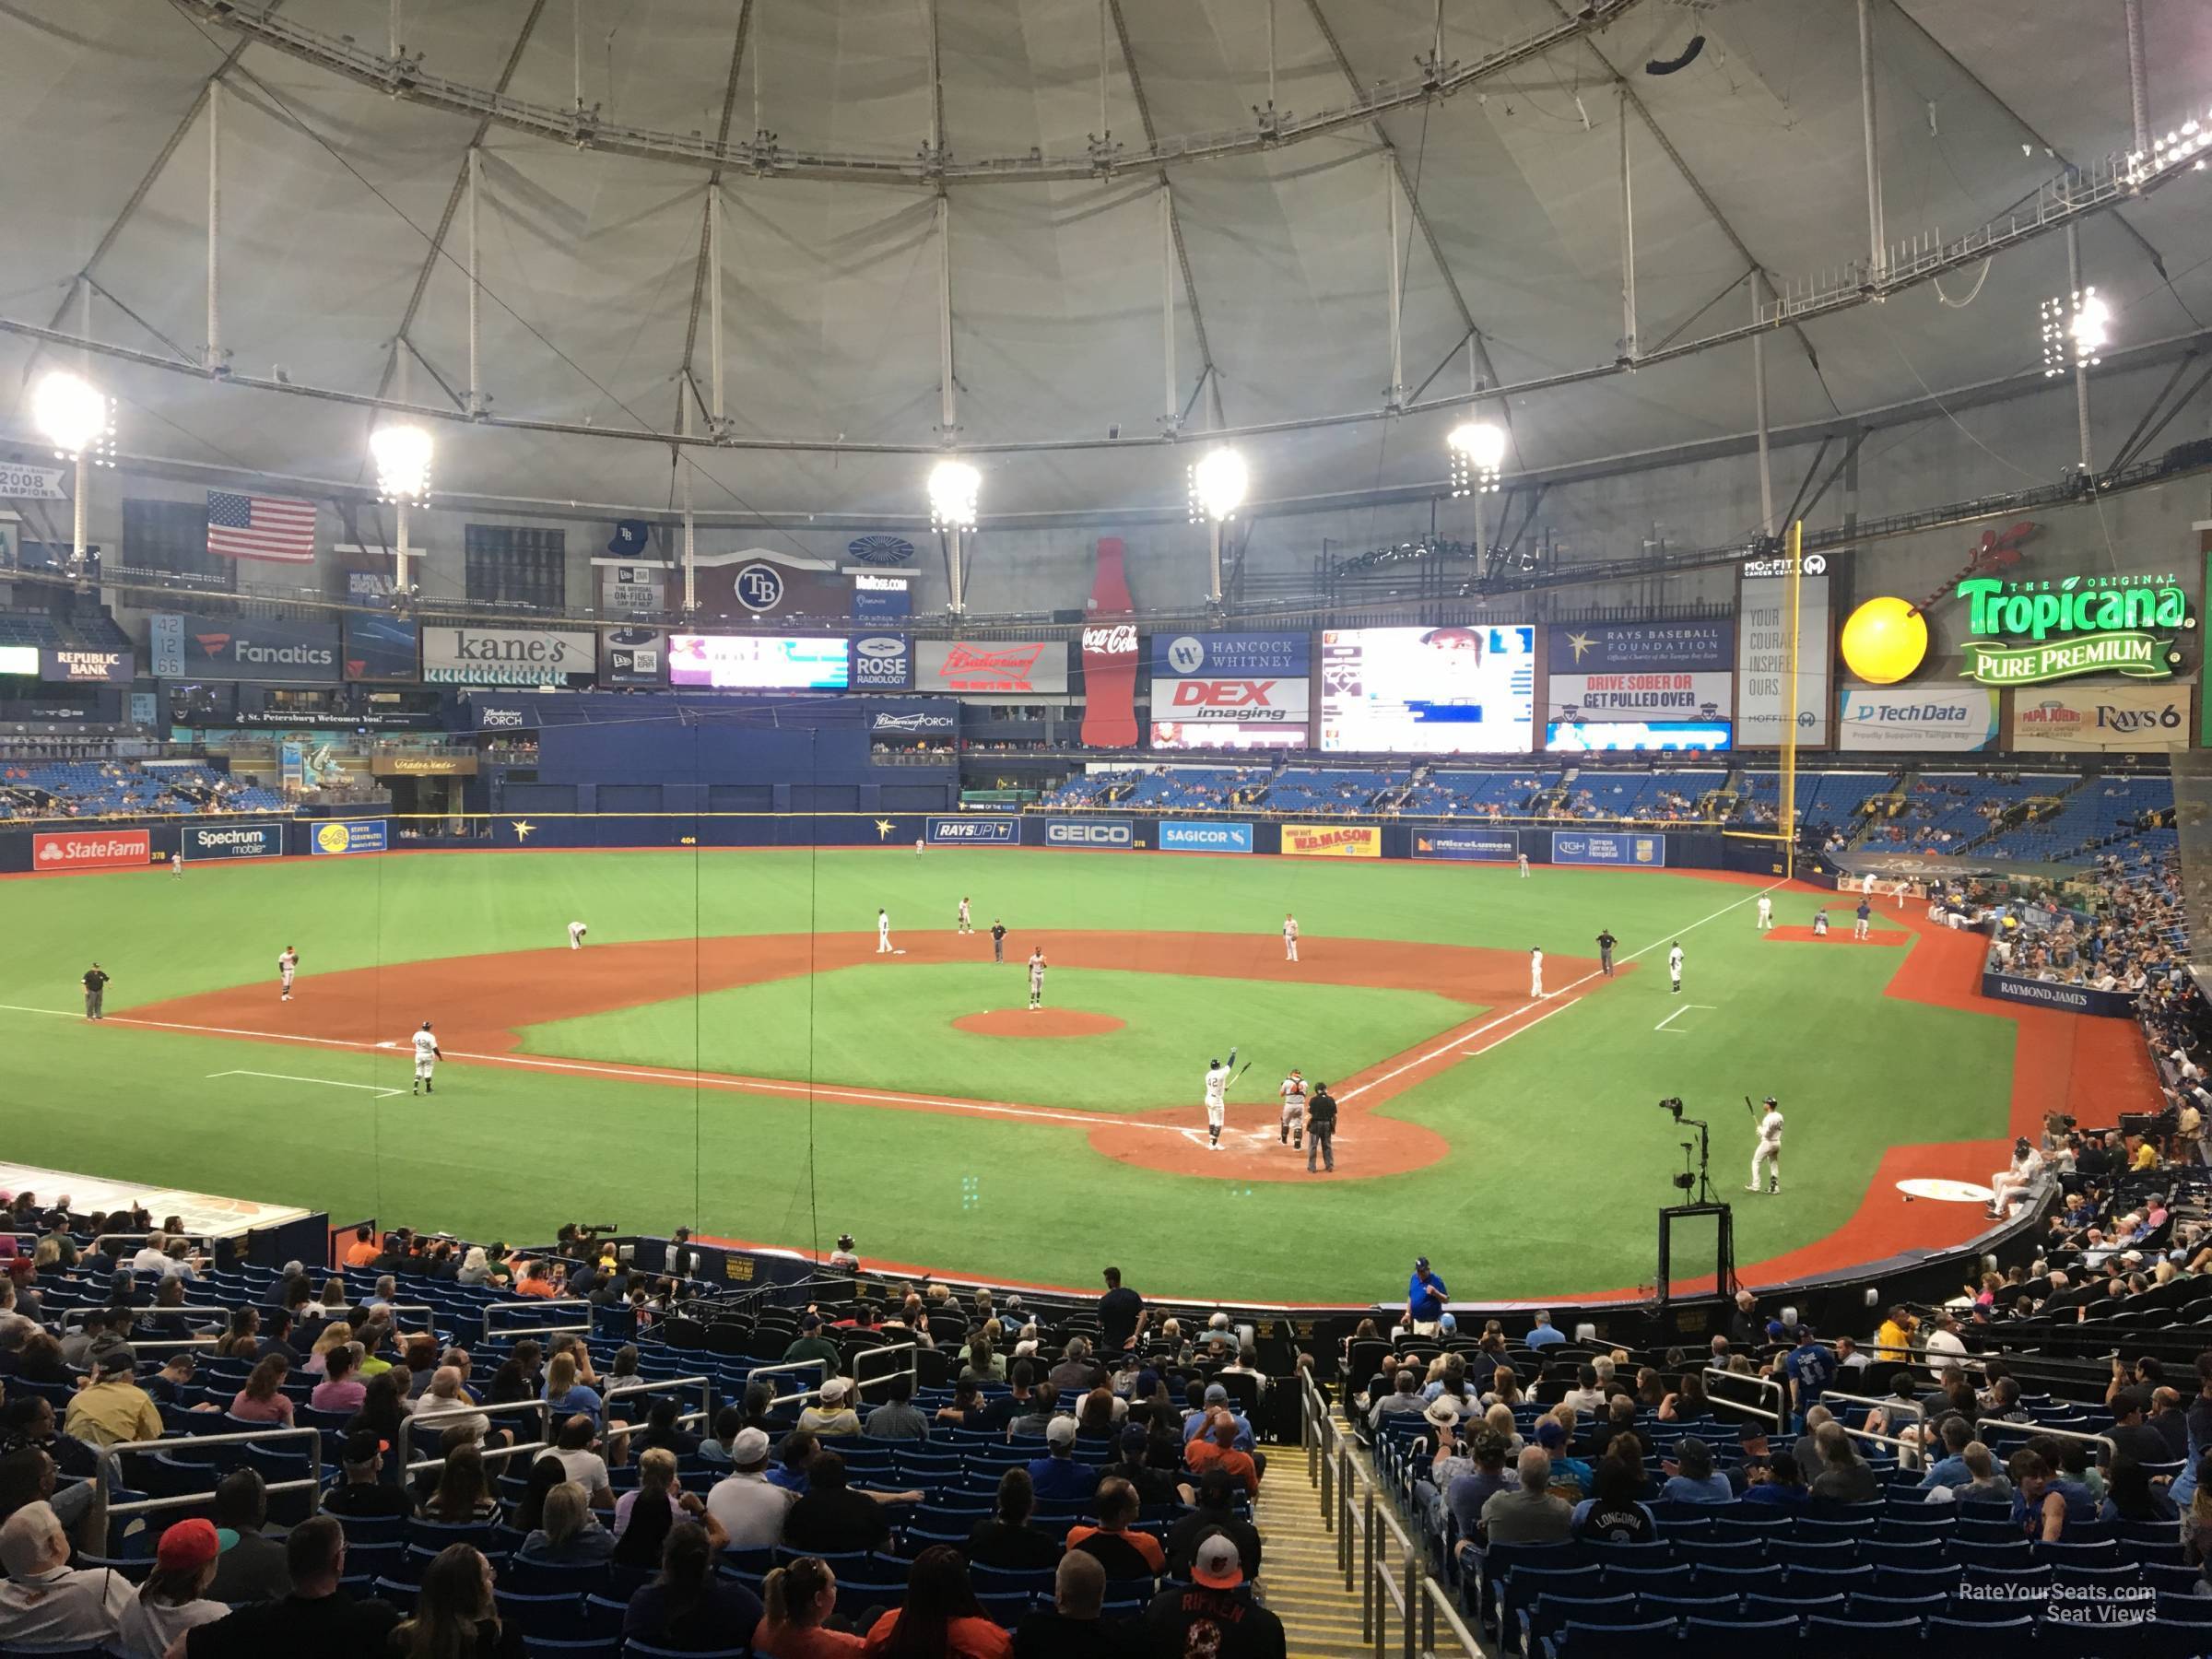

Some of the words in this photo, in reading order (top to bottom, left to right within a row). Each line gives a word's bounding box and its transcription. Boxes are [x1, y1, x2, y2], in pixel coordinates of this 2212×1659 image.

[0, 472, 44, 488] 2008
[0, 486, 55, 498] AMPIONS
[744, 572, 776, 602] TB
[2010, 582, 2050, 593] THE
[2088, 573, 2176, 588] ORIGINAL
[615, 593, 653, 601] ON-FIELD
[1958, 579, 2185, 639] Tropicana
[158, 618, 178, 633] 42
[1750, 609, 1779, 627] YOUR
[1082, 625, 1138, 653] Coca-Cola
[1607, 630, 1641, 640] RAYS
[1649, 629, 1718, 640] BASEBALL
[160, 639, 176, 653] 12
[235, 641, 332, 665] Fanatics
[454, 630, 567, 662] kane's
[1212, 641, 1292, 653] HANCOCK
[1608, 641, 1718, 651] FOUNDATION
[57, 652, 120, 665] REPUBLIC
[158, 658, 179, 673] 66
[1213, 656, 1292, 668] WHITNEY
[1977, 653, 2037, 677] PURE
[2041, 640, 2152, 674] PREMIUM
[70, 664, 108, 675] BANK
[857, 658, 907, 675] ROSE
[857, 676, 907, 684] RADIOLOGY
[1587, 676, 1625, 690] DRIVE
[1628, 675, 1669, 690] SOBER
[1673, 675, 1692, 689] OR
[1172, 680, 1278, 707] DEX
[1583, 694, 1606, 708] GET
[1610, 693, 1658, 708] PULLED
[1661, 692, 1695, 707] OVER
[264, 714, 315, 723] Petersburg
[318, 714, 360, 723] Welcomes
[483, 716, 523, 725] PORCH
[1197, 706, 1286, 720] imaging
[2023, 710, 2047, 723] PAPA
[2159, 704, 2182, 728] 6
[919, 717, 953, 726] PORCH
[197, 830, 263, 848] Spectrum
[1049, 825, 1130, 842] GEICO
[1167, 830, 1228, 842] SAGICOR
[232, 843, 263, 854] mobile
[1436, 840, 1512, 849] MicroLumen
[2001, 982, 2052, 1000] RAYMOND
[2053, 991, 2088, 1006] JAMES
[1595, 1512, 1642, 1531] LONGORIA
